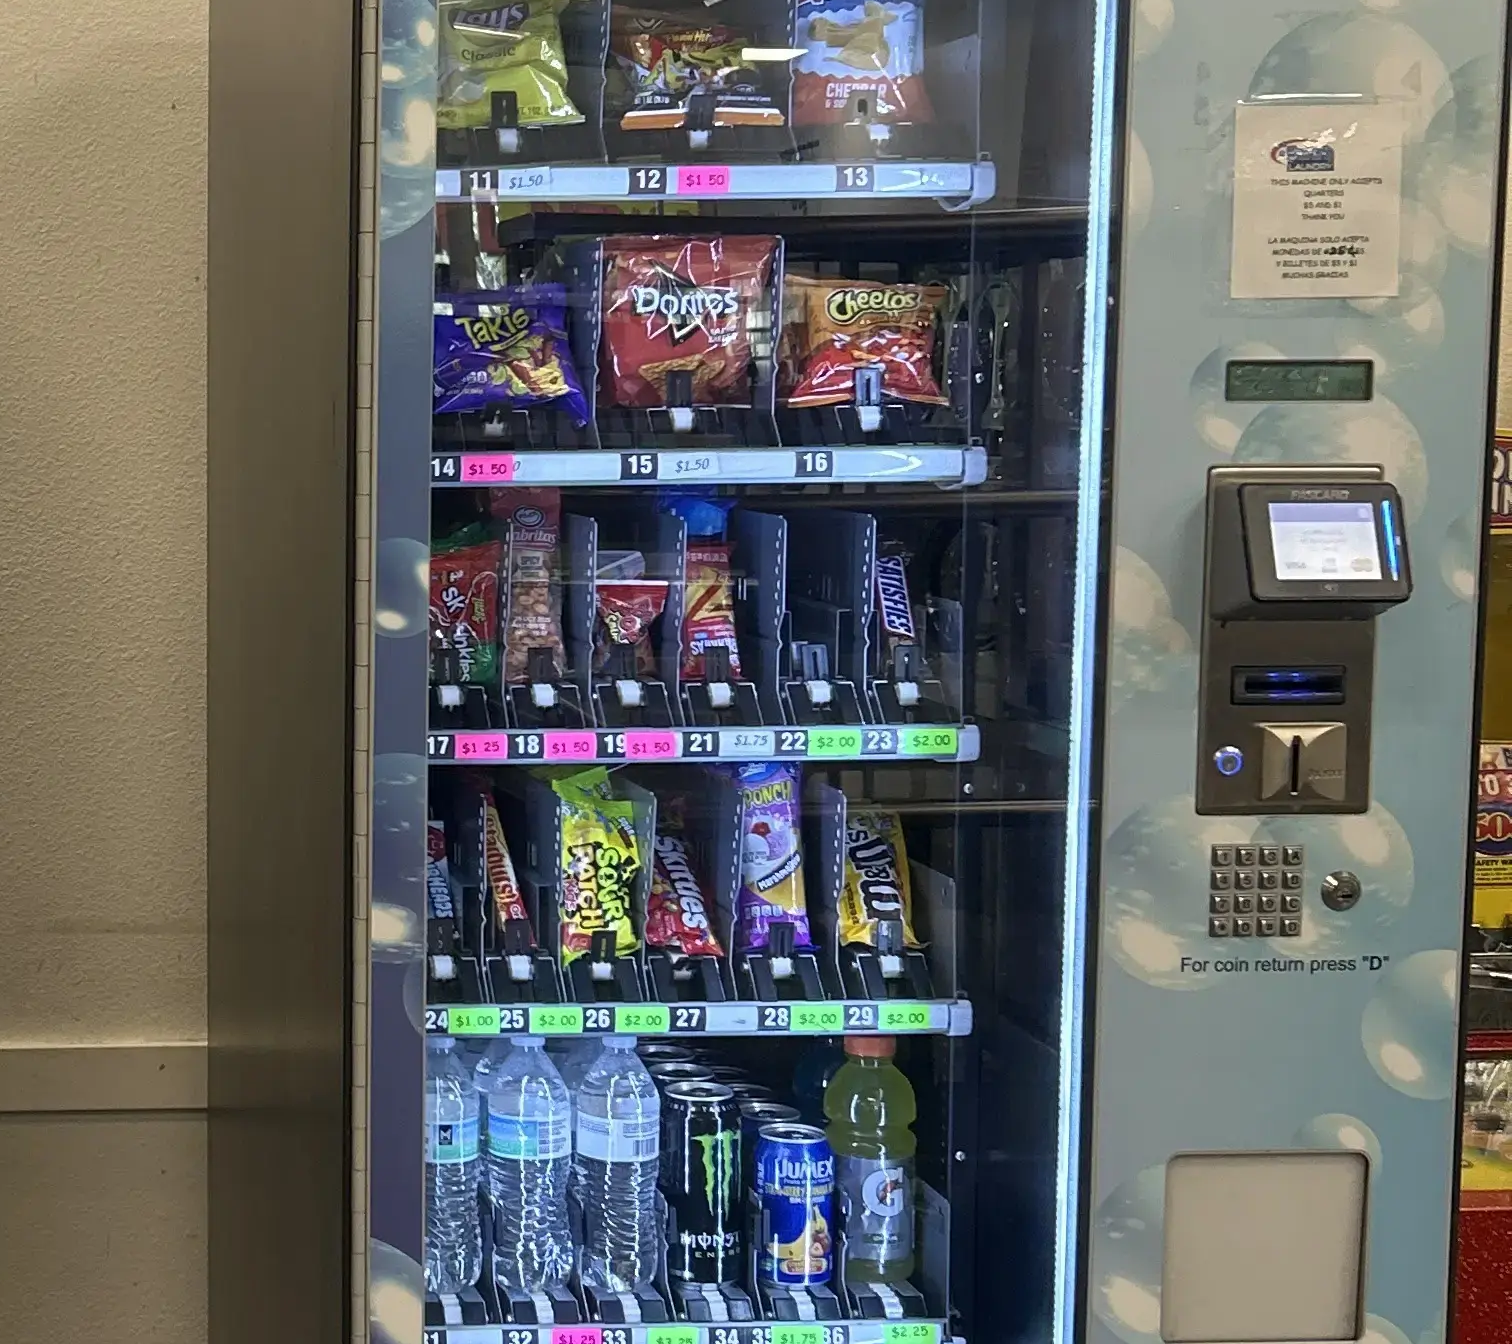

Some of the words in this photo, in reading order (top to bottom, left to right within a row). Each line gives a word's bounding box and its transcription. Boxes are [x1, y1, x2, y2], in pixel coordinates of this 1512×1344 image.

[636, 169, 661, 189] 12
[843, 167, 869, 187] 13
[826, 288, 922, 324] Cheetos
[454, 304, 530, 350] Takis
[431, 458, 455, 477] 14
[627, 455, 653, 475] 15
[803, 453, 828, 472] 16
[879, 557, 913, 636] SATISFIES
[427, 736, 449, 754] 17
[515, 735, 540, 754] 18
[690, 732, 713, 752] 21
[781, 731, 806, 750] 22
[867, 730, 892, 749] 23
[596, 847, 625, 921] SOUR
[1181, 957, 1209, 973] For
[1215, 957, 1249, 972] coin
[1254, 957, 1304, 972] return
[1310, 958, 1356, 974] press
[426, 1011, 448, 1029] 24
[500, 1010, 524, 1028] 25
[586, 1009, 611, 1028] 26
[676, 1009, 701, 1027] 27
[764, 1008, 789, 1027] 28
[848, 1007, 873, 1026] 29
